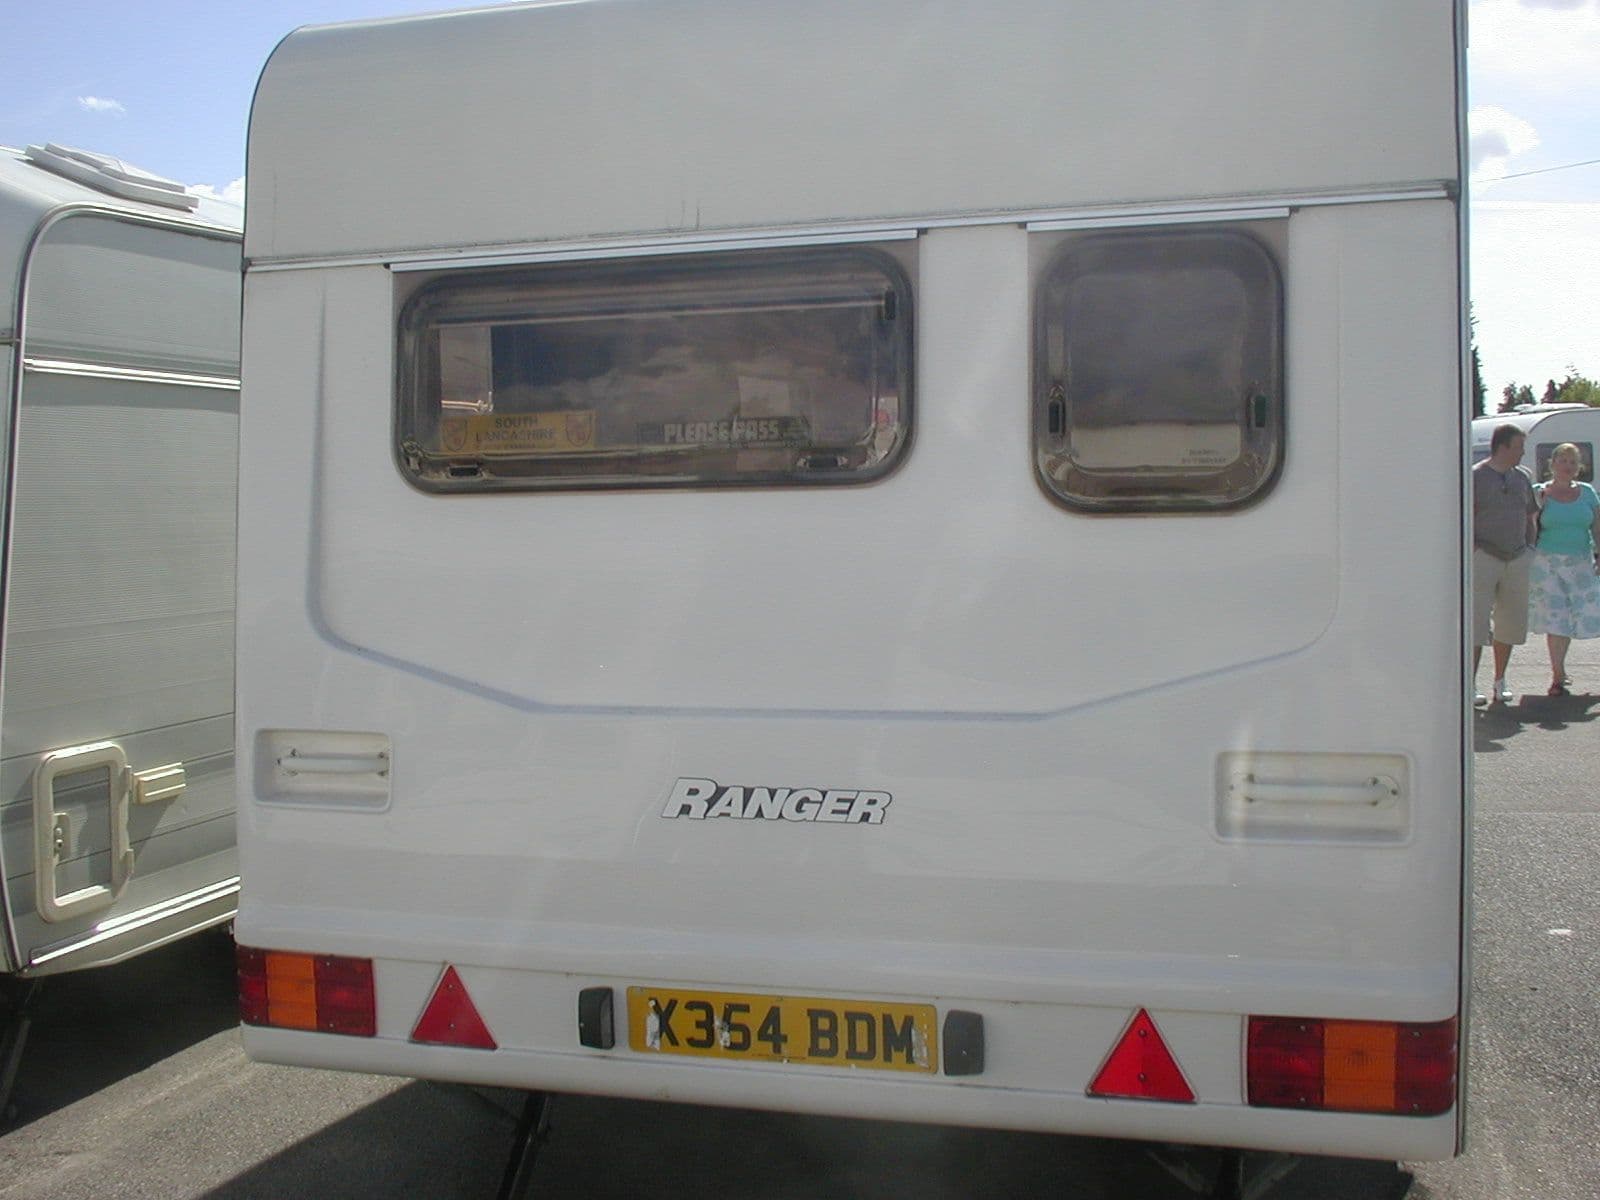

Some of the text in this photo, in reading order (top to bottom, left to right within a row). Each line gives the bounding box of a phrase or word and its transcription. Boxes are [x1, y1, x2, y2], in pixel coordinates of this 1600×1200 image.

[495, 415, 538, 430] SOUTH
[663, 420, 729, 443] PLEASE
[661, 777, 893, 824] RANGER
[648, 997, 917, 1065] X354 BDM
